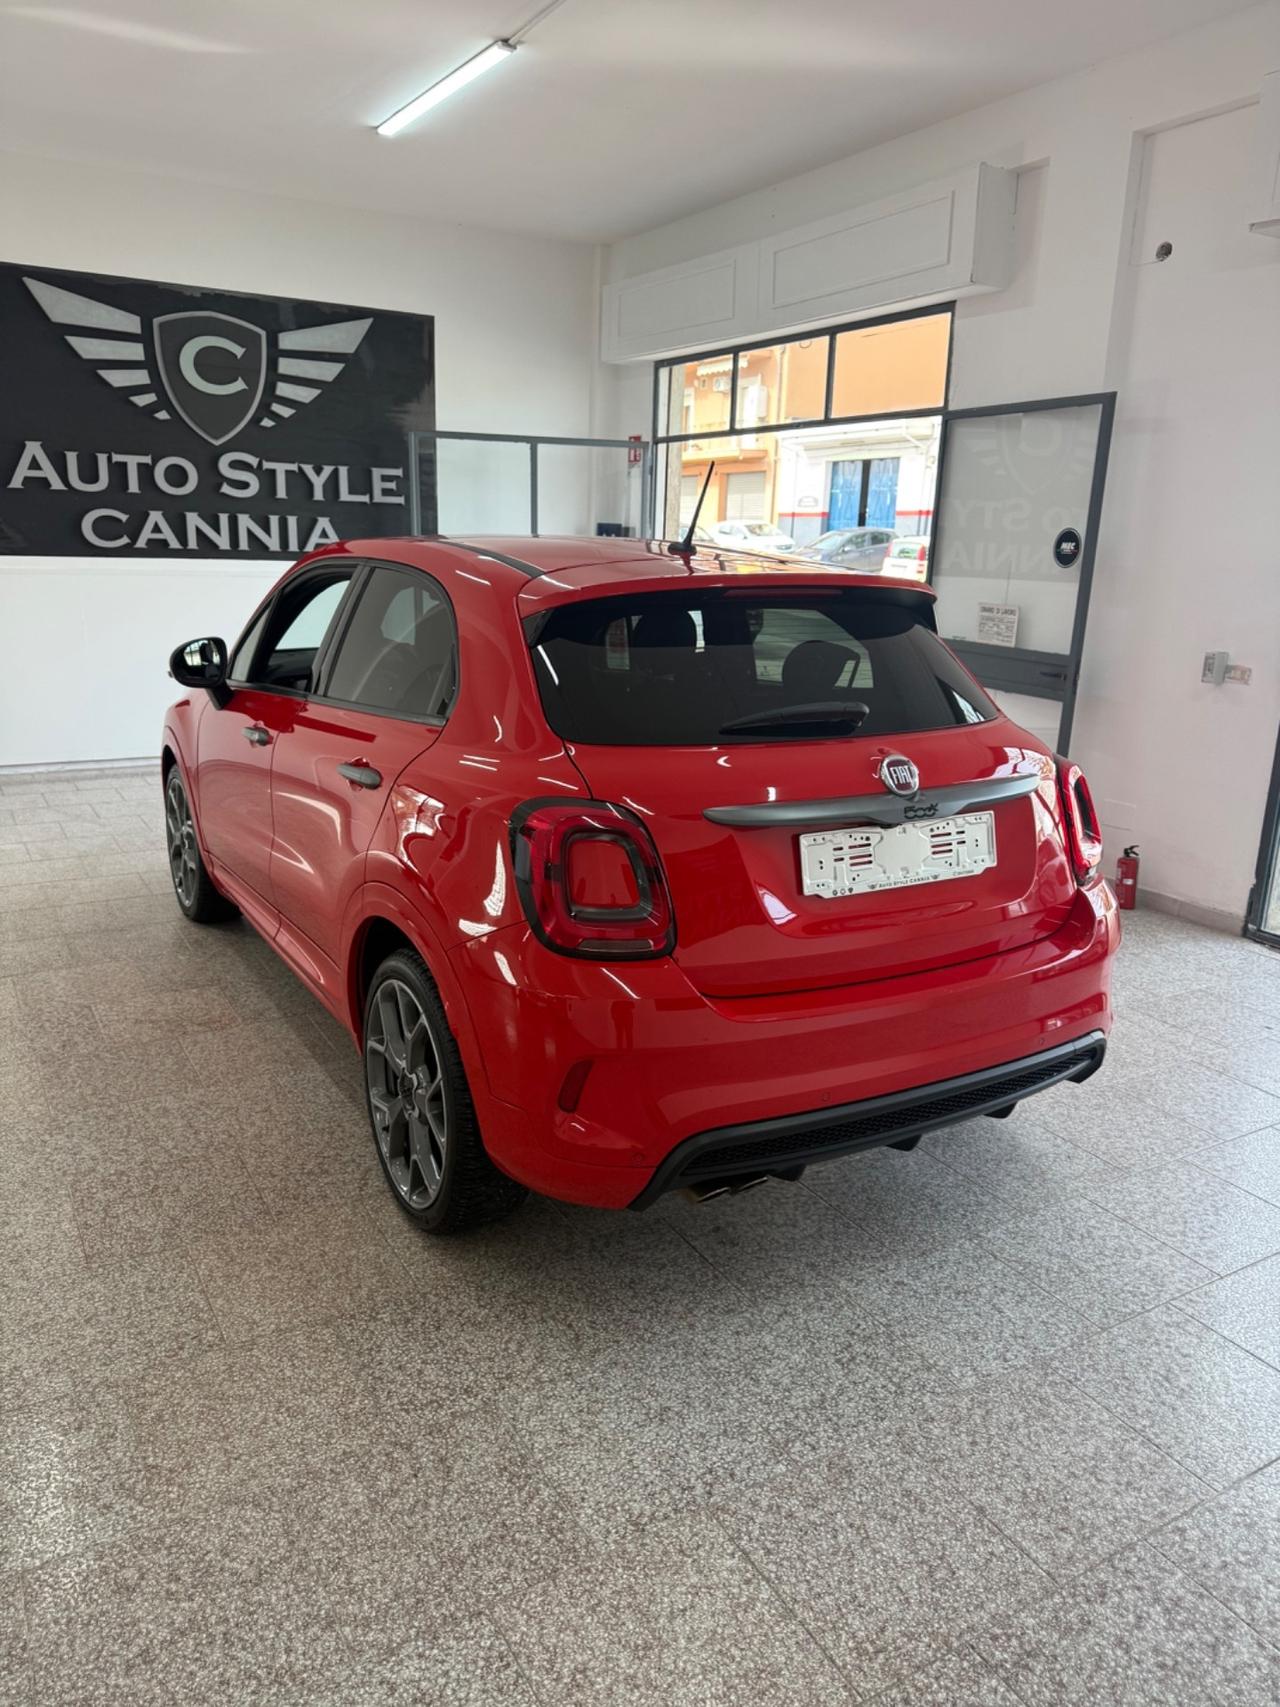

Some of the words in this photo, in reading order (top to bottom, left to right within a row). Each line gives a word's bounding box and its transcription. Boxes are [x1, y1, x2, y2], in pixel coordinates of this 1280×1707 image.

[179, 335, 248, 395] C
[7, 440, 199, 496] AUTO
[217, 451, 405, 505] STYLE
[81, 508, 340, 552] CANNIA
[890, 765, 914, 785] FIAT
